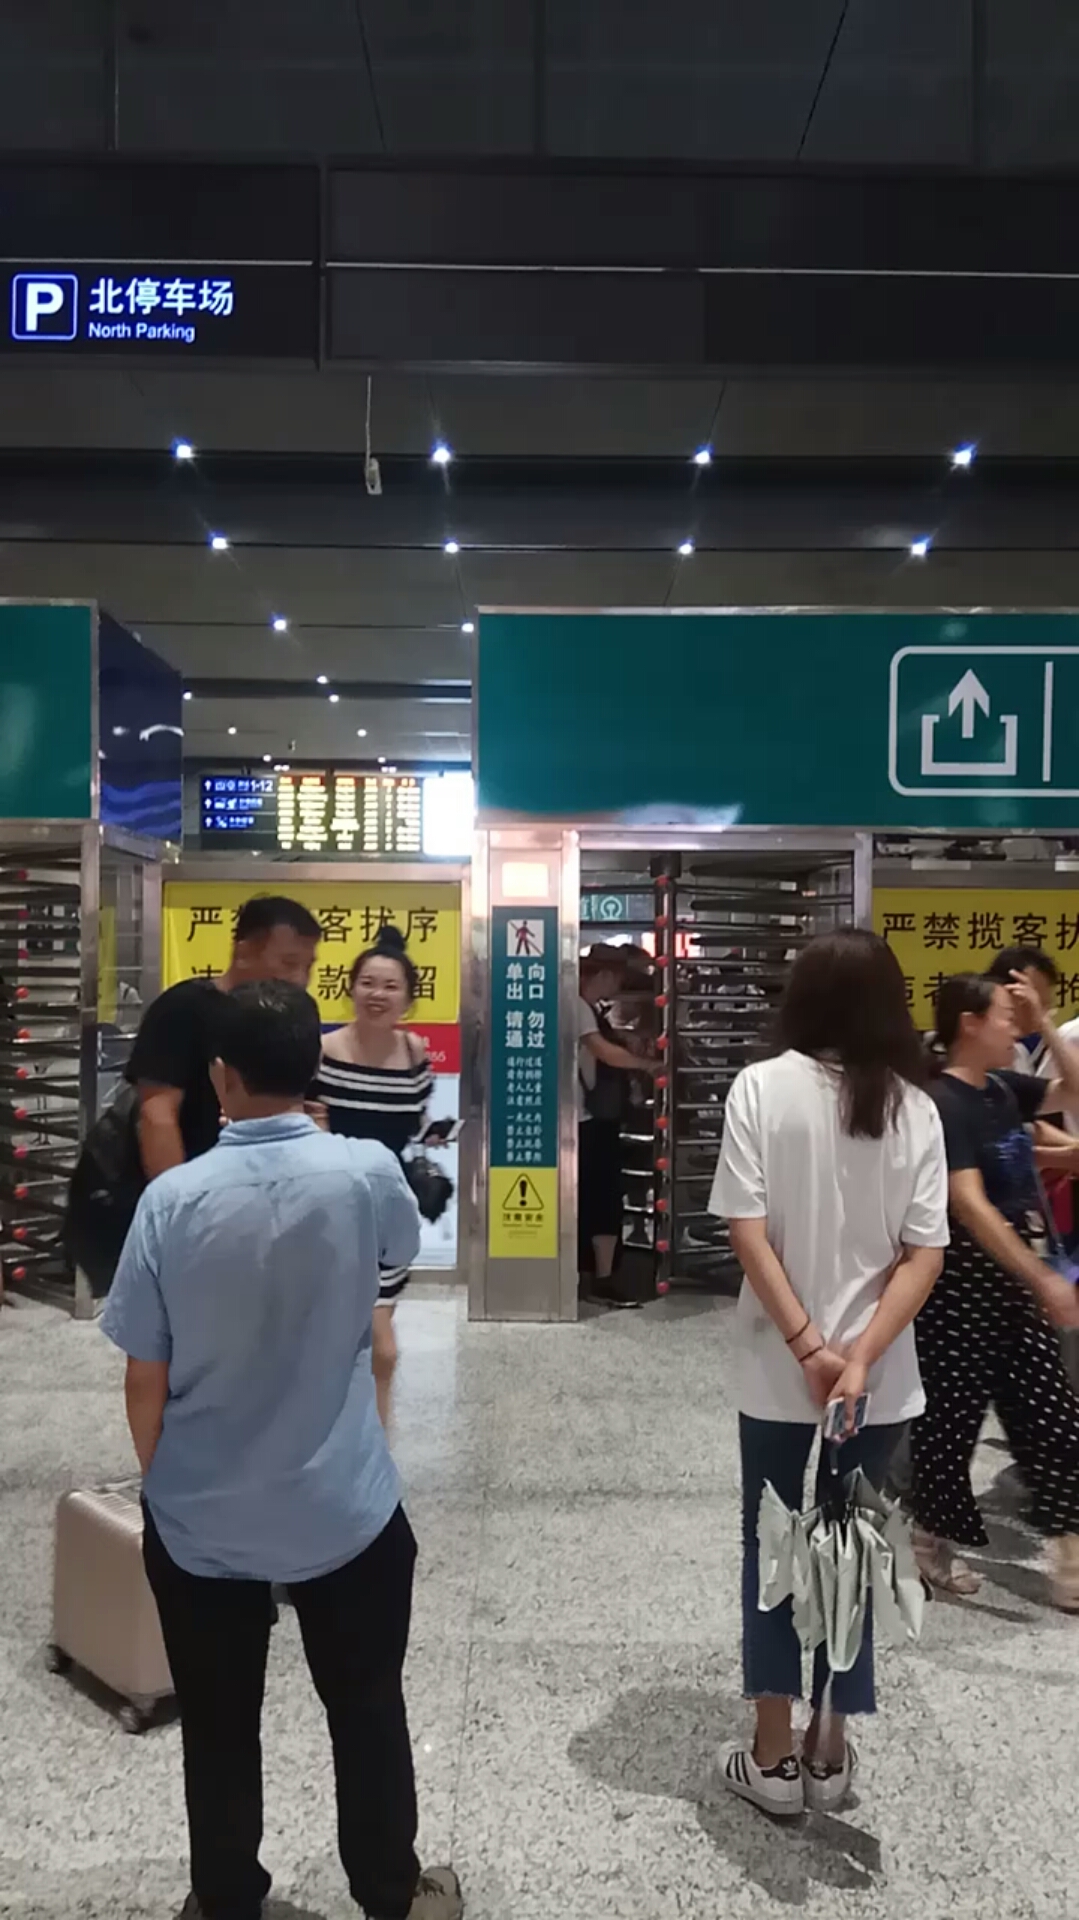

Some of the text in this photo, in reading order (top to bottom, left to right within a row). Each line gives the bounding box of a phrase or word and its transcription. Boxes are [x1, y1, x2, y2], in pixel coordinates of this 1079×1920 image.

[89, 278, 234, 316] 北停车场
[25, 282, 64, 331] P
[89, 323, 195, 342] North Parking
[506, 963, 545, 980] 单向
[507, 983, 544, 1000] 出口
[505, 1011, 545, 1028] 请勿
[505, 1031, 545, 1048] 通过
